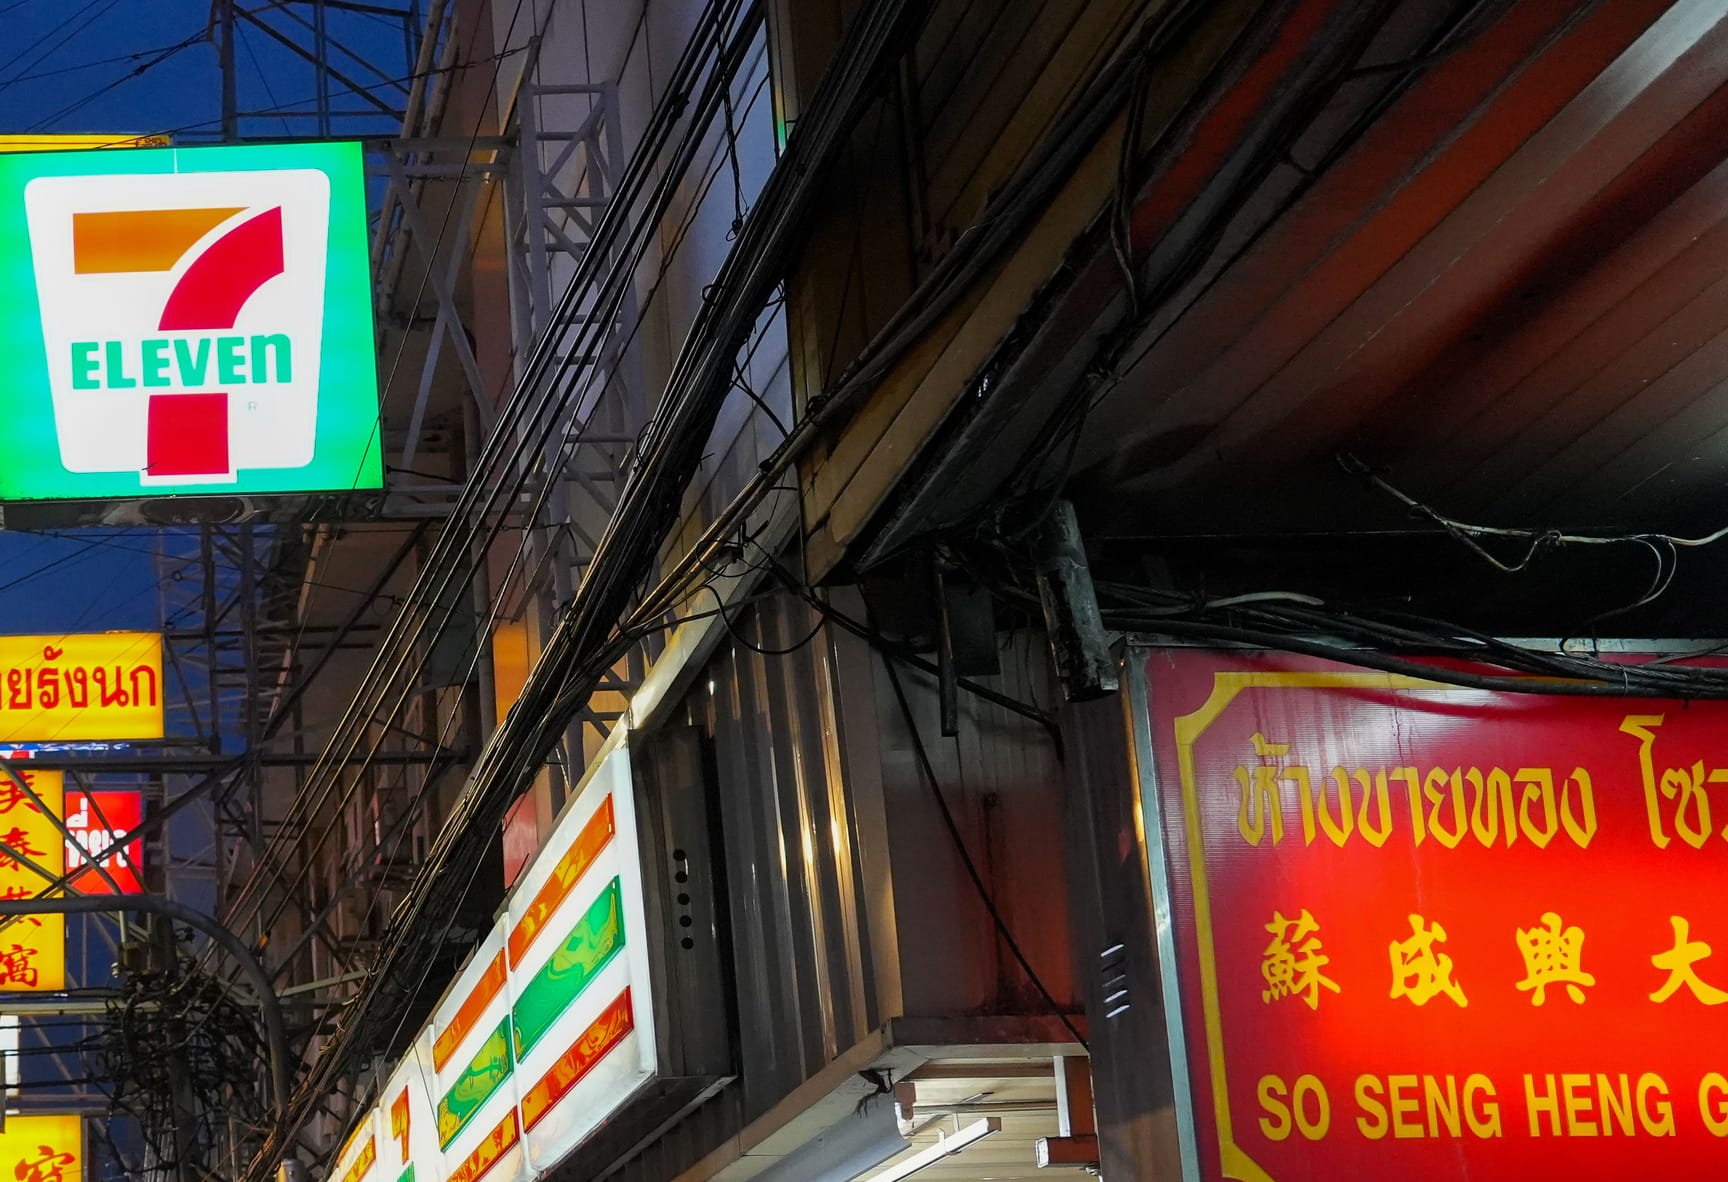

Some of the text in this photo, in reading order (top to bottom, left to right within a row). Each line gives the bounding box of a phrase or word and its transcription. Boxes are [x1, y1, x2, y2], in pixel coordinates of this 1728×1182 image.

[1257, 1074, 1331, 1141] SO
[1354, 1073, 1503, 1141] SENG
[1525, 1072, 1677, 1139] HENG
